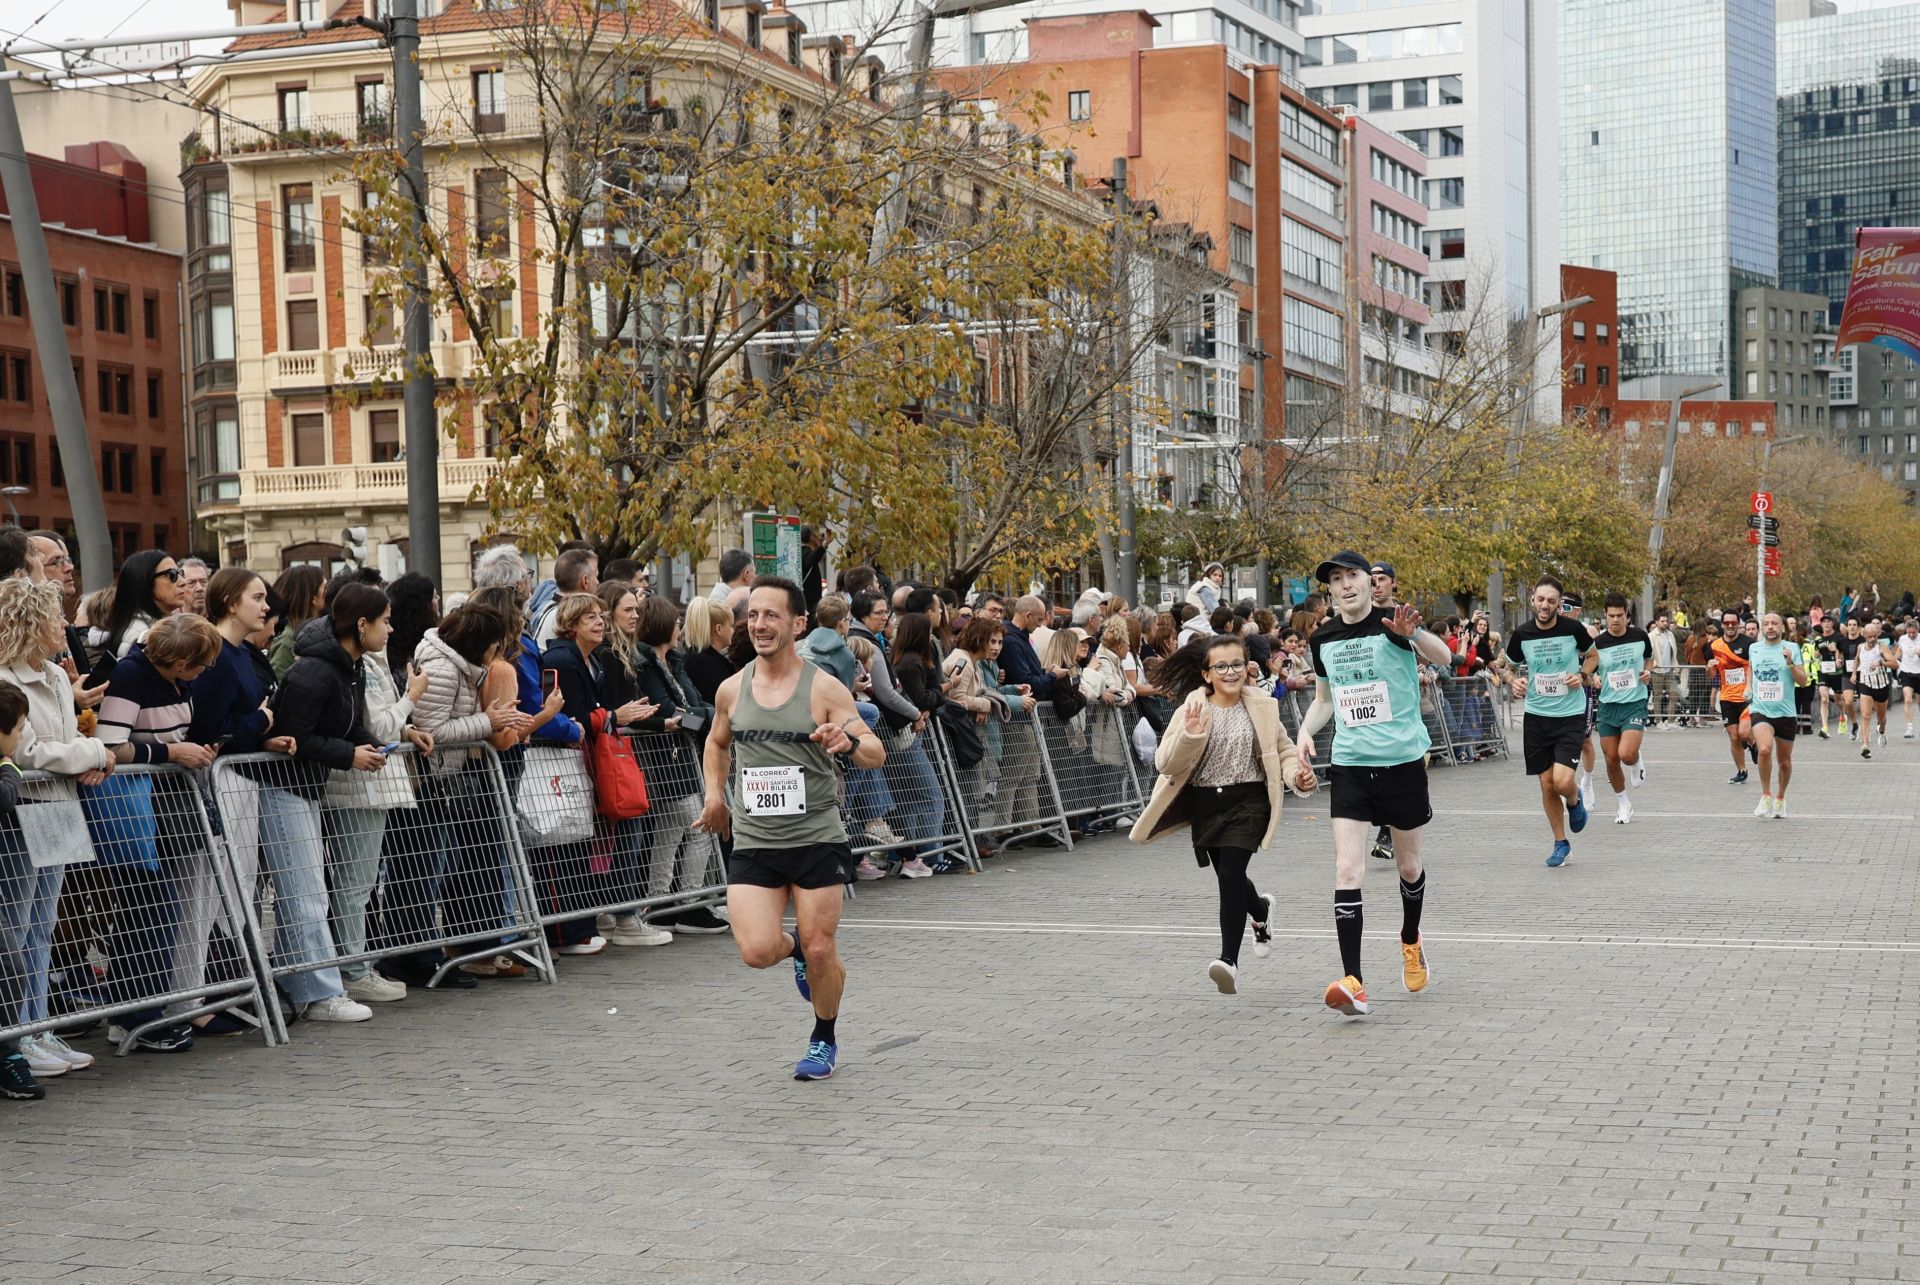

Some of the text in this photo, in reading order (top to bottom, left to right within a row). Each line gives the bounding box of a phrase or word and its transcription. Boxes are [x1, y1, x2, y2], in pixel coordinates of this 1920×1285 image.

[1857, 243, 1904, 269] Fair
[1340, 697, 1360, 707] XXXVI
[1350, 705, 1377, 720] 1002
[746, 781, 769, 791] XXXVI
[757, 793, 785, 808] 2801
